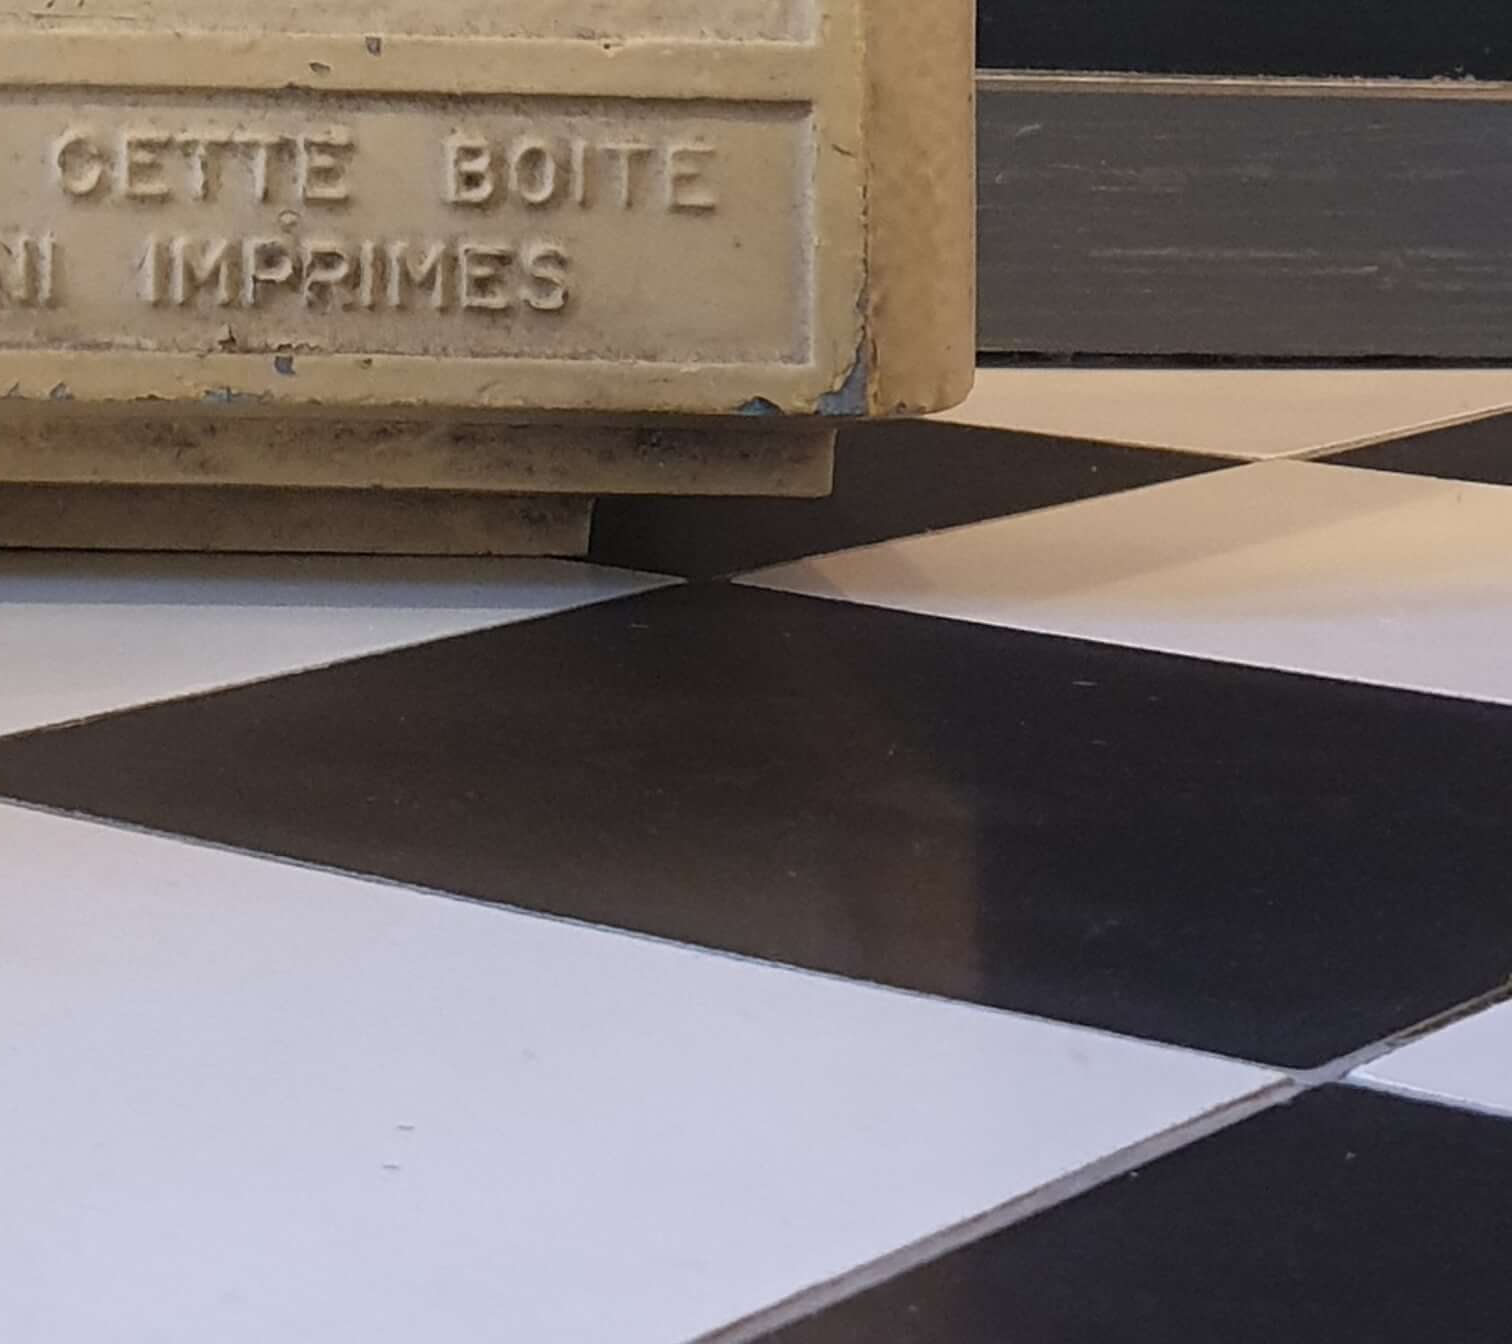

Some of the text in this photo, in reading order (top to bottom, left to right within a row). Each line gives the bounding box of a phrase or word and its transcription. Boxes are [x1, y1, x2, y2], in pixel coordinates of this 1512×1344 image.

[53, 124, 358, 205] CETTE
[441, 130, 718, 215] BOITE
[138, 233, 575, 314] IMPRIMES
